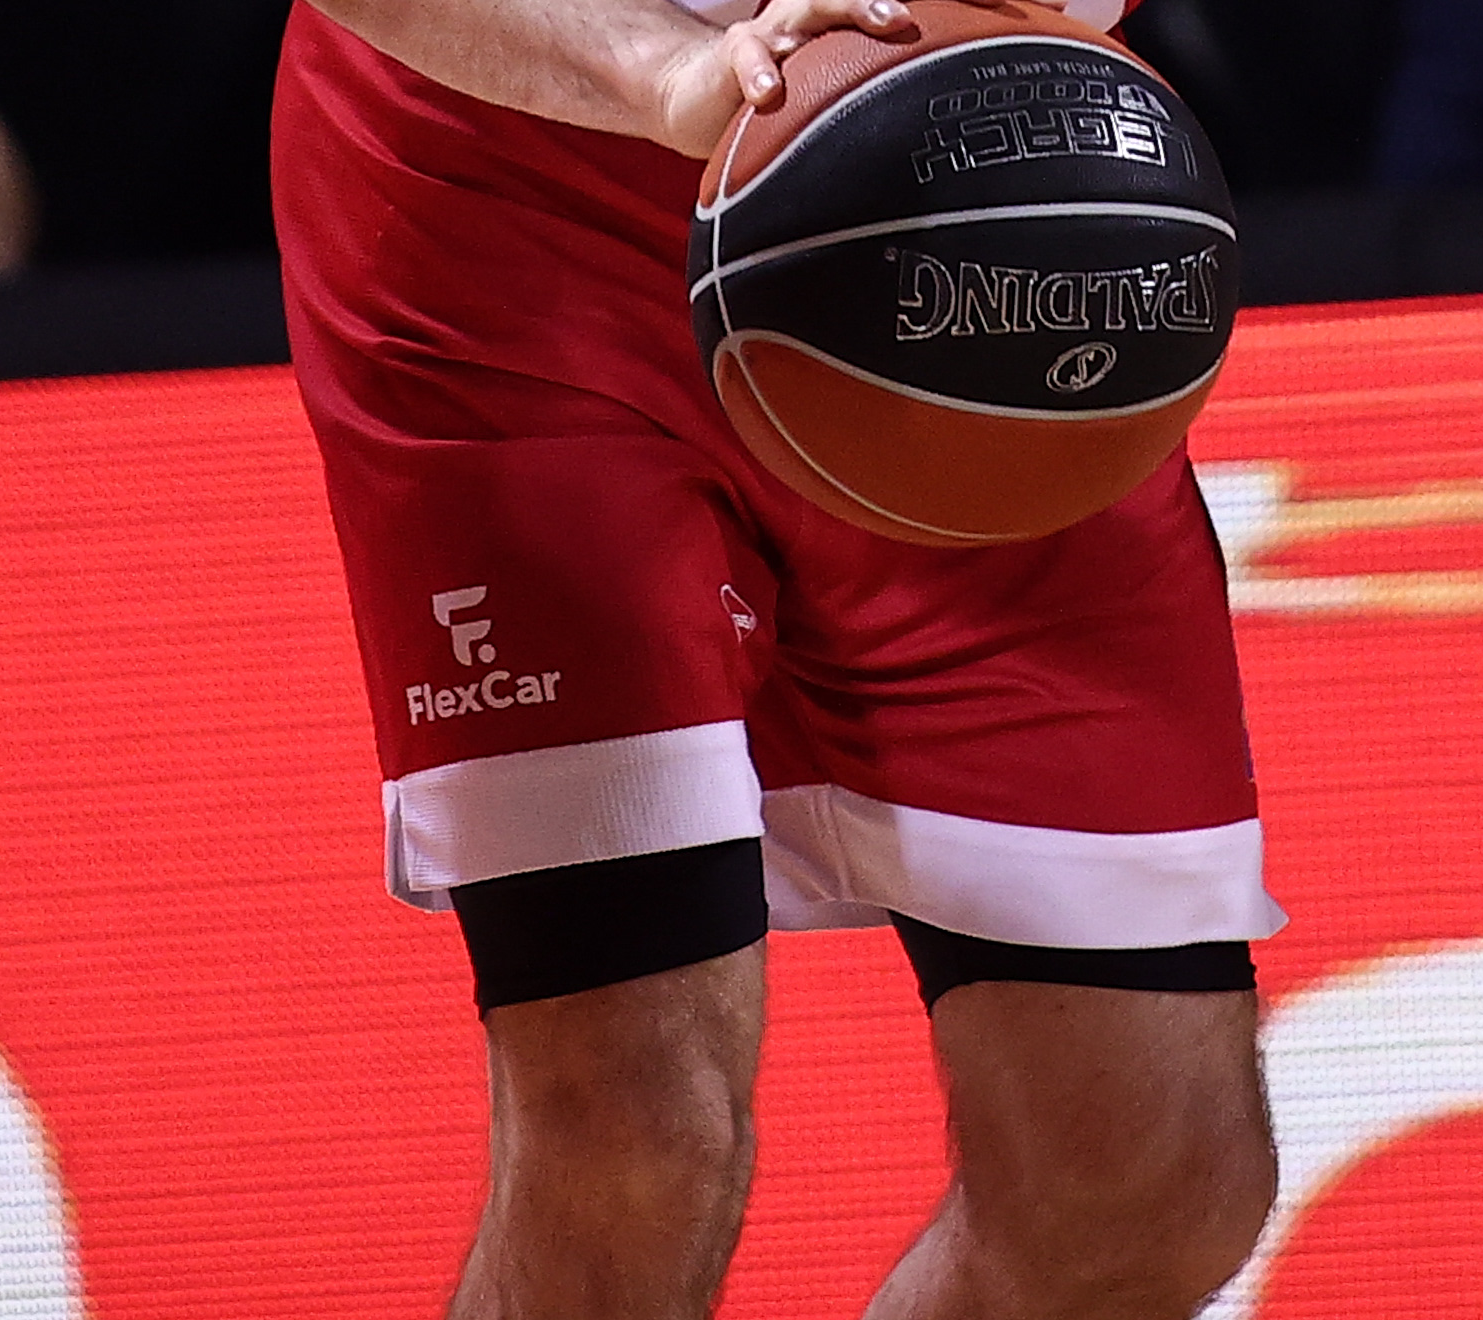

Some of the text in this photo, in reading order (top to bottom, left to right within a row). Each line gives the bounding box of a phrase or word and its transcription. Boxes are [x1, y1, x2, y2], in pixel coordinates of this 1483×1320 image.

[909, 107, 1198, 185] LEGACY
[894, 244, 1219, 341] SPALDING
[405, 668, 561, 727] FlexCar
